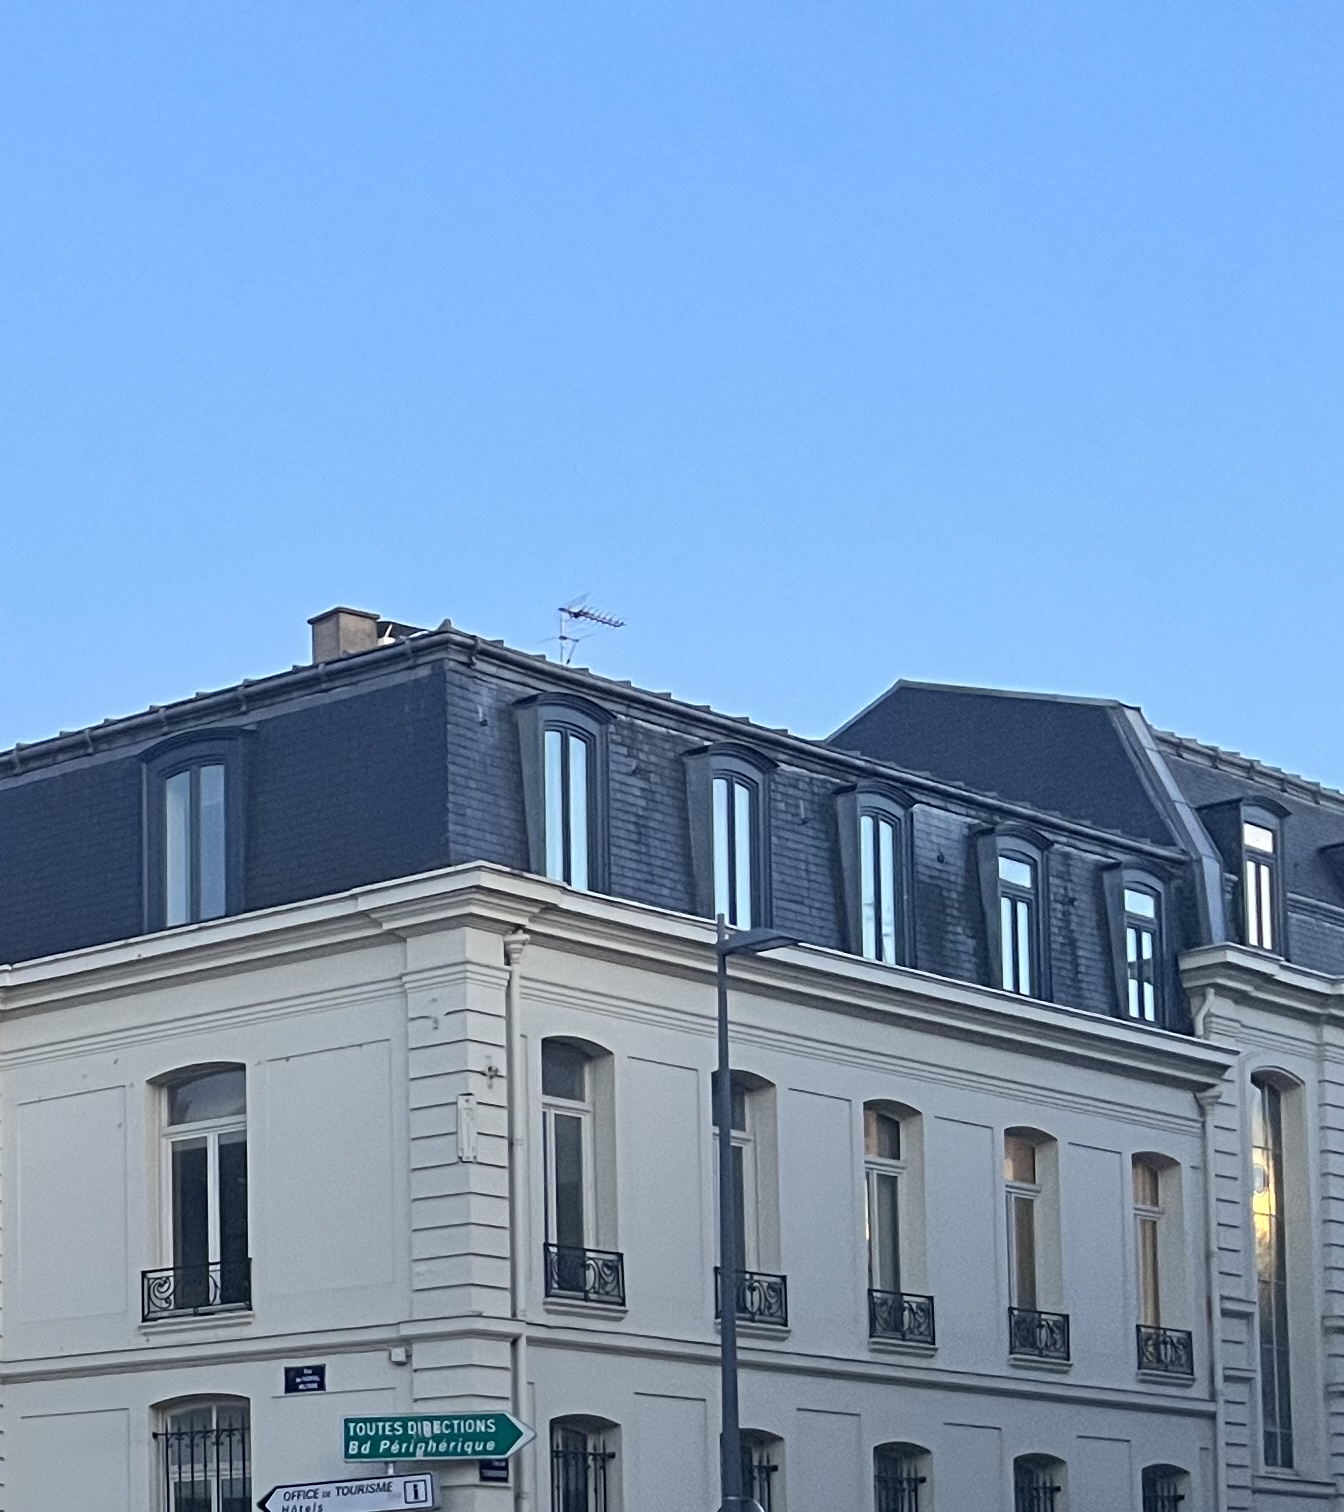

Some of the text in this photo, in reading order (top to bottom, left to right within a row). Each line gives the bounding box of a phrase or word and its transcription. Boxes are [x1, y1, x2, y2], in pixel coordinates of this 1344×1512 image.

[347, 1421, 404, 1437] TOUTES
[348, 1437, 496, 1457] Bd Périphérique
[283, 1488, 320, 1502] OFFICE
[335, 1482, 393, 1497] TOURISME
